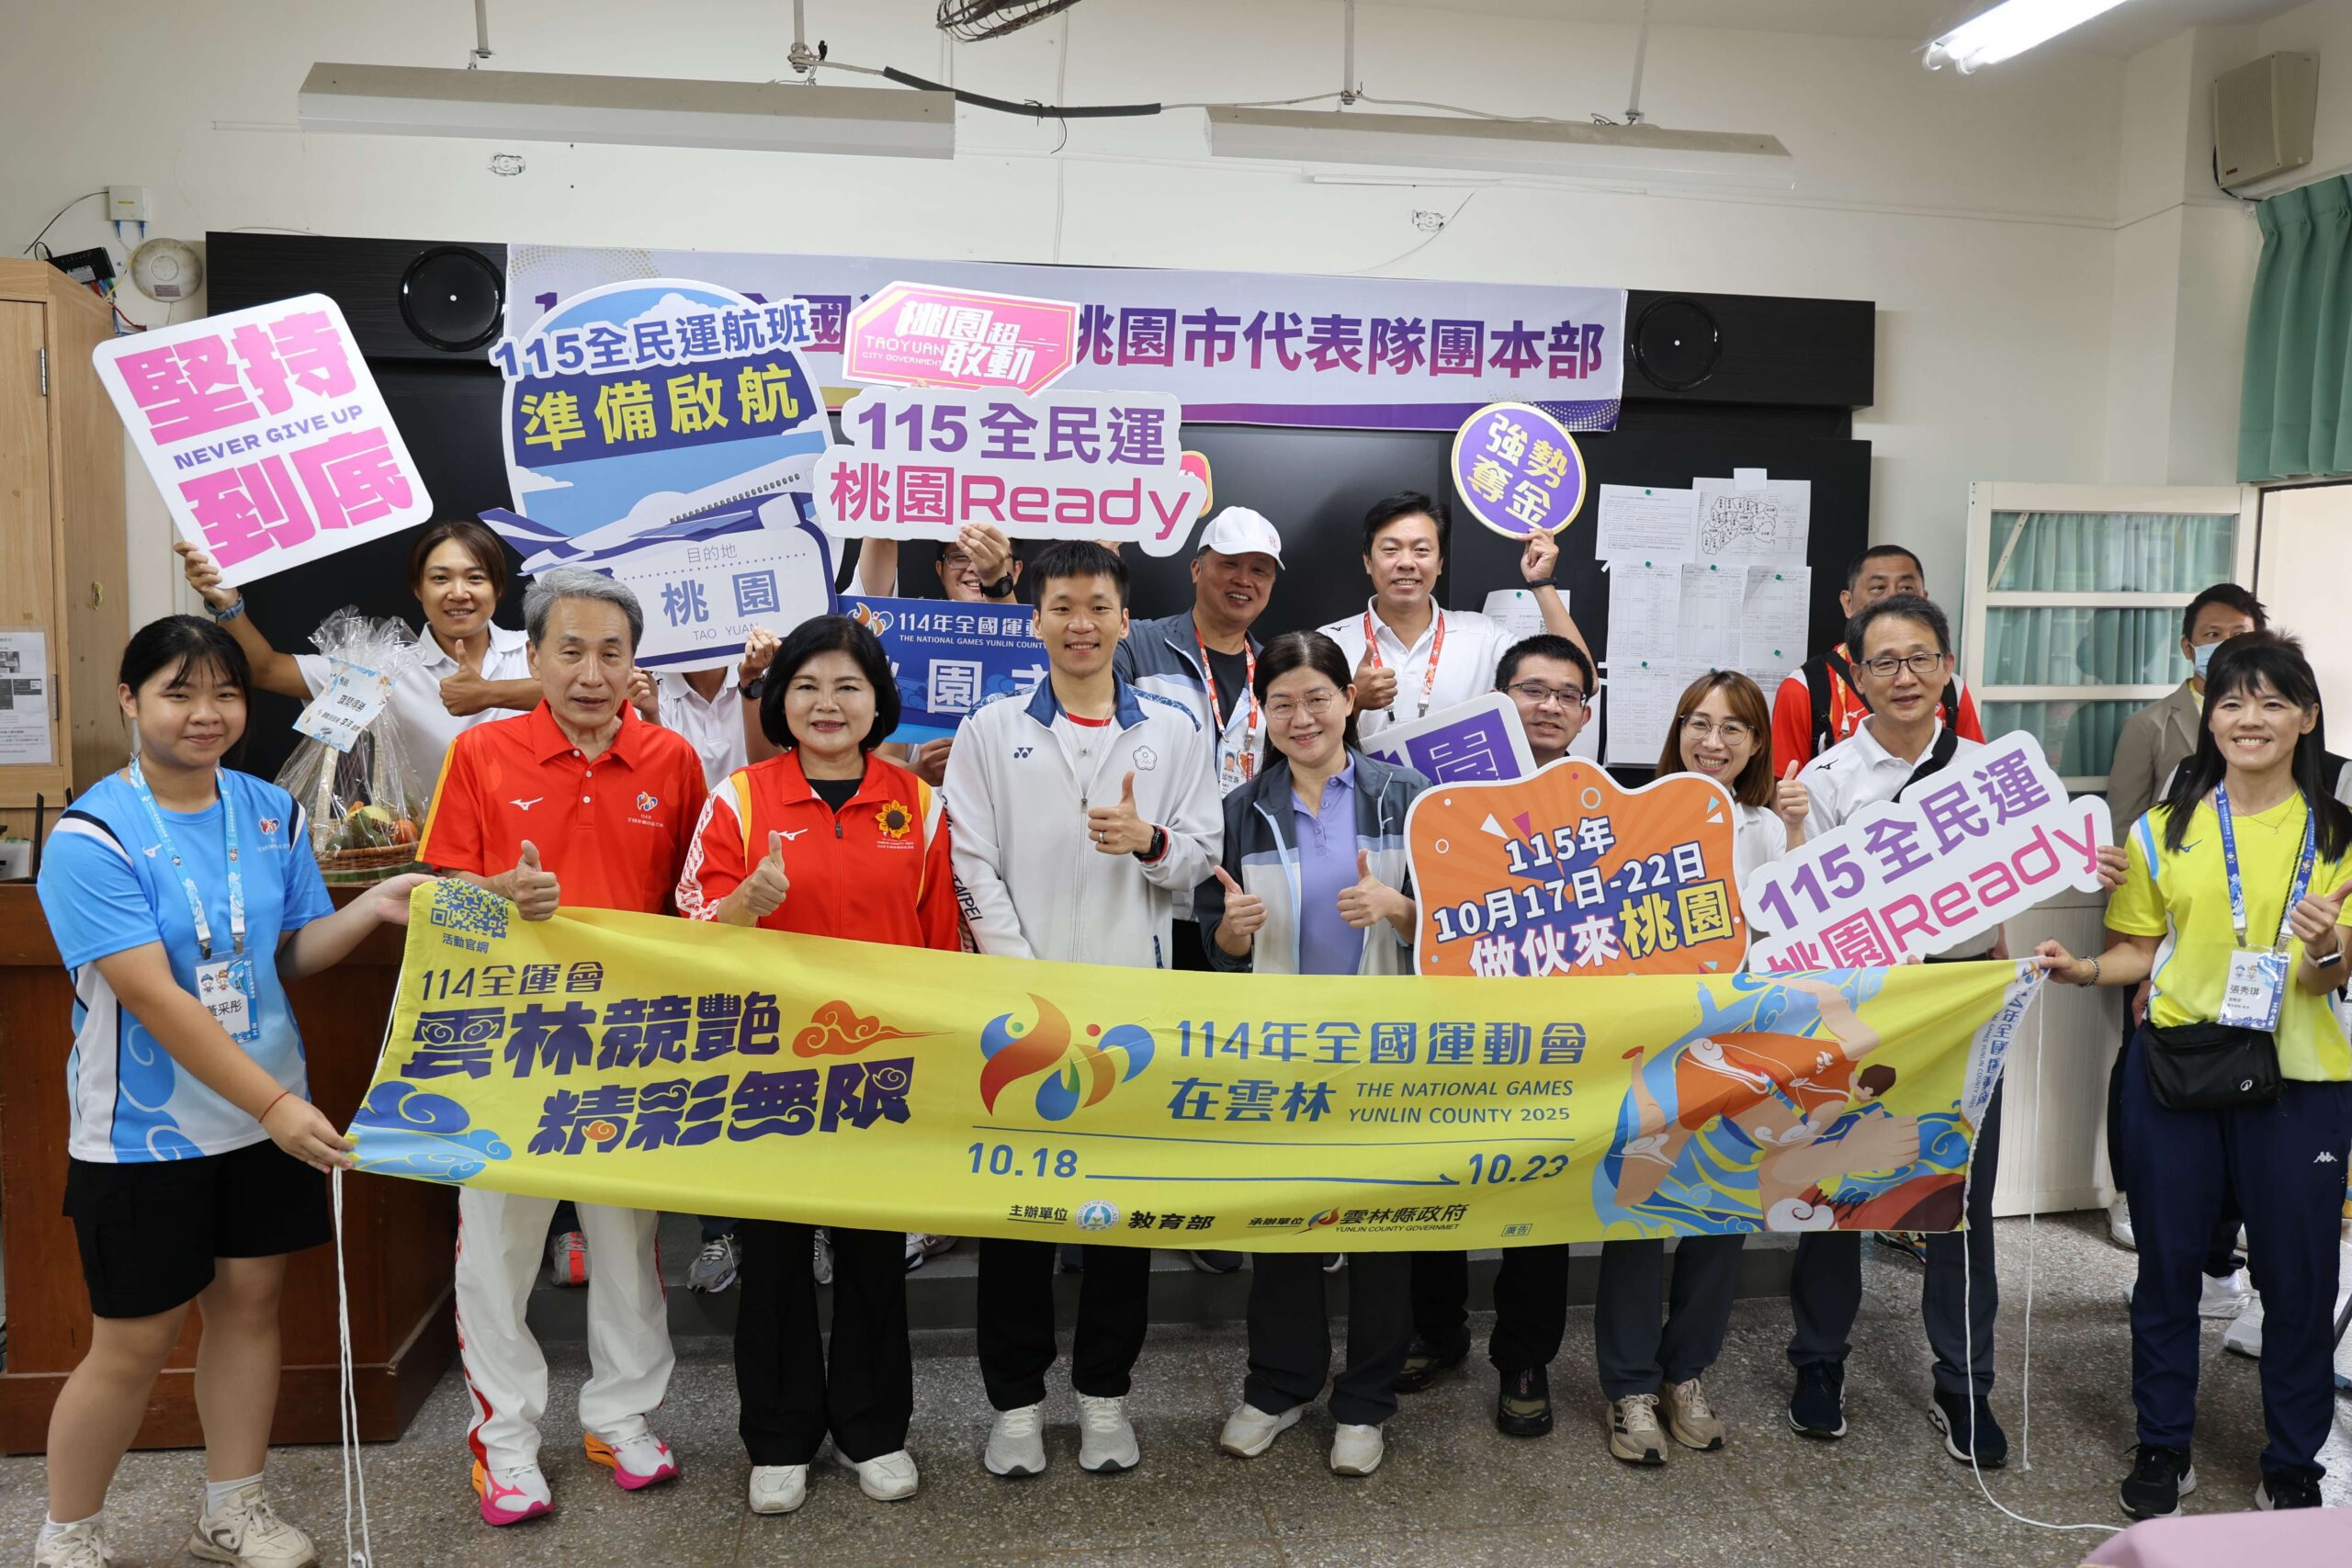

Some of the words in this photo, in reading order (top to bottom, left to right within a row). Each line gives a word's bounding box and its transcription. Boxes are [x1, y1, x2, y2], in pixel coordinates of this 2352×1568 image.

[496, 303, 809, 376] 115全民運航班
[863, 352, 883, 360] CITY
[886, 354, 944, 367] GOVERNMENT
[865, 334, 946, 356] TAOYUAN
[114, 310, 356, 446] 堅持
[520, 363, 799, 451] 準備啟航
[174, 434, 261, 469] NEVER
[266, 414, 329, 443] GIVE
[331, 405, 363, 423] UP
[858, 401, 1165, 466] 115全民運
[1486, 413, 1567, 488] 強勢
[177, 426, 413, 569] 到底
[831, 462, 1191, 539] 桃園Ready
[1467, 454, 1551, 528] 奪金
[687, 543, 737, 563] 目的地
[662, 570, 780, 627] 桃園
[693, 629, 717, 640] TAO
[899, 635, 914, 643] THE
[917, 636, 955, 645] NATIONAL
[956, 637, 983, 646] GAMES
[986, 639, 1014, 648] YUNLIN
[1505, 816, 1615, 874] 115年
[1758, 749, 2051, 931] 115全民運
[954, 874, 983, 920] TAIPEI
[1433, 840, 1706, 942] 10月17日-22日
[442, 932, 490, 954] 活動官網
[1469, 880, 1734, 977] 做伙來桃園
[422, 961, 604, 1000] 114全運會
[1175, 1020, 1587, 1066] 114年全國運動會
[527, 1056, 914, 1156] 精彩無限
[1167, 1077, 1337, 1122] 在雲林
[1356, 1082, 1395, 1098] THE
[1401, 1081, 1498, 1098] NATIONAL
[1506, 1080, 1573, 1097] GAMES
[1349, 1108, 1423, 1123] YUNLIN
[1429, 1108, 1513, 1123] COUNTY
[1521, 1107, 1570, 1122] 2025
[968, 1142, 1078, 1178] 10.18
[1470, 1154, 1569, 1185] 10.23
[1010, 1205, 1069, 1221] 主辦單位
[1128, 1211, 1216, 1230] 教育部
[1248, 1216, 1305, 1225] 承辦單位
[1340, 1203, 1469, 1224] 雲林縣政府
[1505, 1225, 1527, 1235] 廣告
